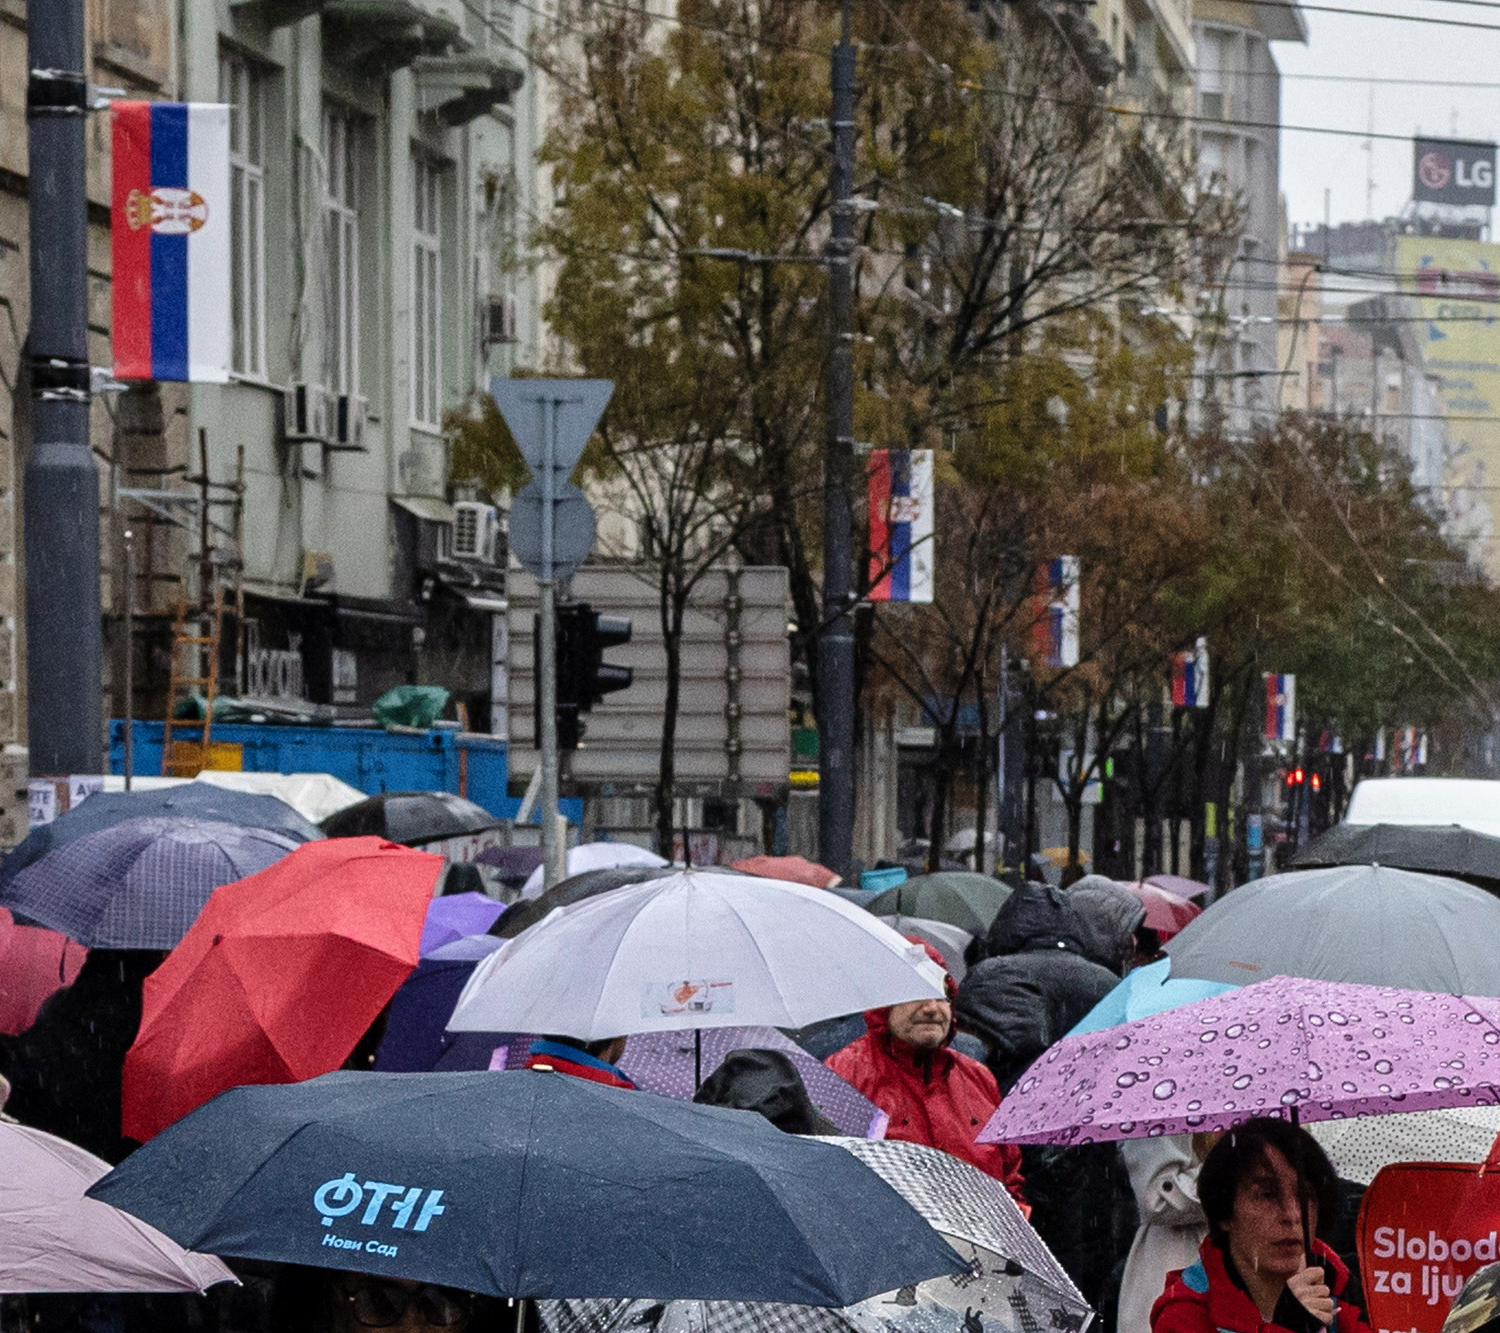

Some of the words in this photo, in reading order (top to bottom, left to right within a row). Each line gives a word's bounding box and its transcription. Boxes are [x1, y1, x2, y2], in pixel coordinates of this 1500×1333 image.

[1455, 159, 1493, 188] LG
[313, 1172, 445, 1231] ФТН
[321, 1233, 363, 1251] Нови
[365, 1240, 398, 1258] Сад
[1373, 1270, 1412, 1294] za
[1421, 1265, 1463, 1305] lju
